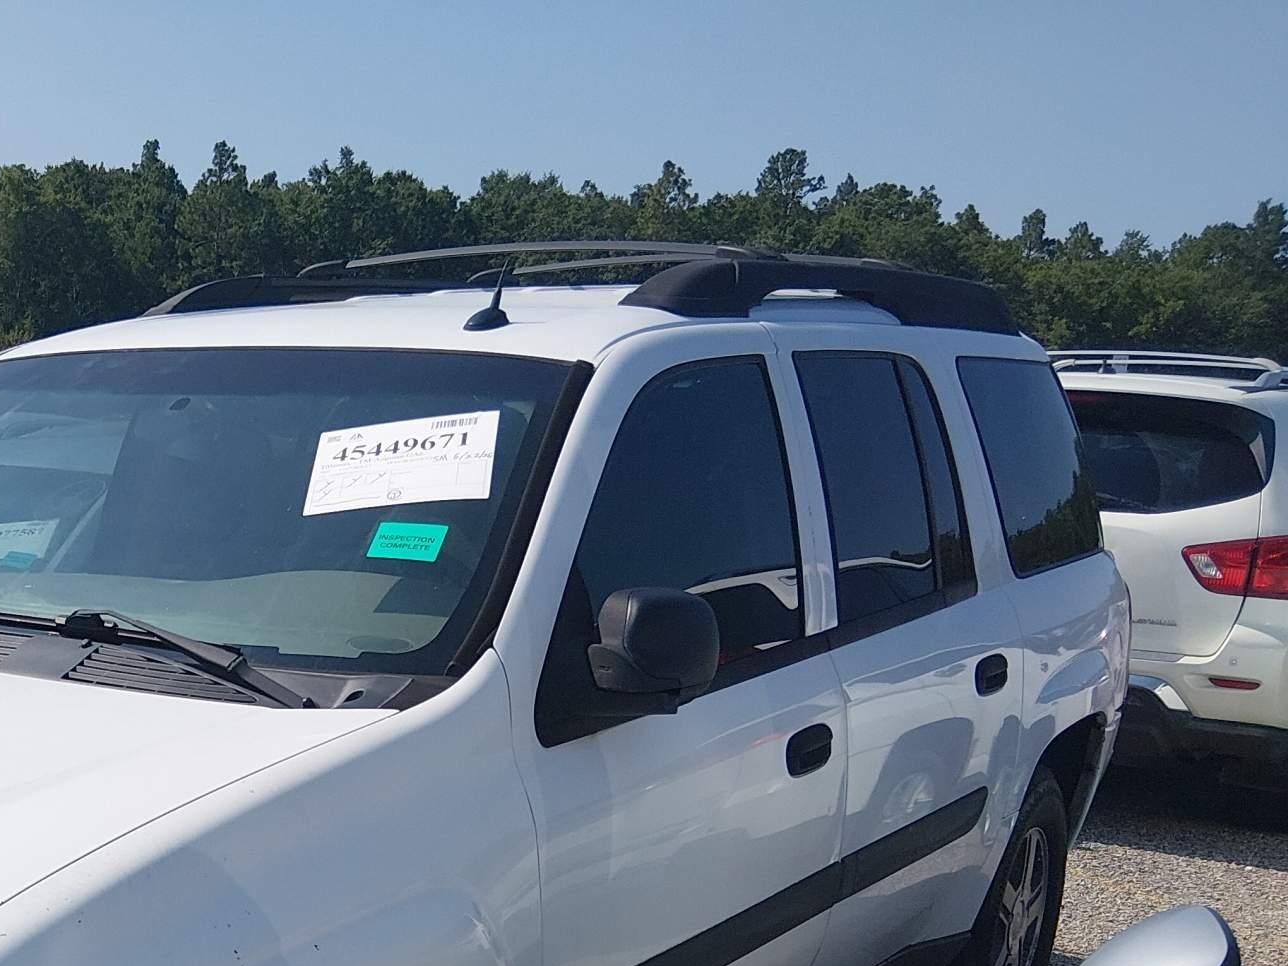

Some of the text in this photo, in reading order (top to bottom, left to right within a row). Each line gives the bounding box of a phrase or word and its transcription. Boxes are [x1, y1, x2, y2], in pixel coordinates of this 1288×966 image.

[333, 432, 469, 462] 45449671
[378, 534, 436, 544] INSPECTION
[379, 542, 431, 551] COMPLETE
